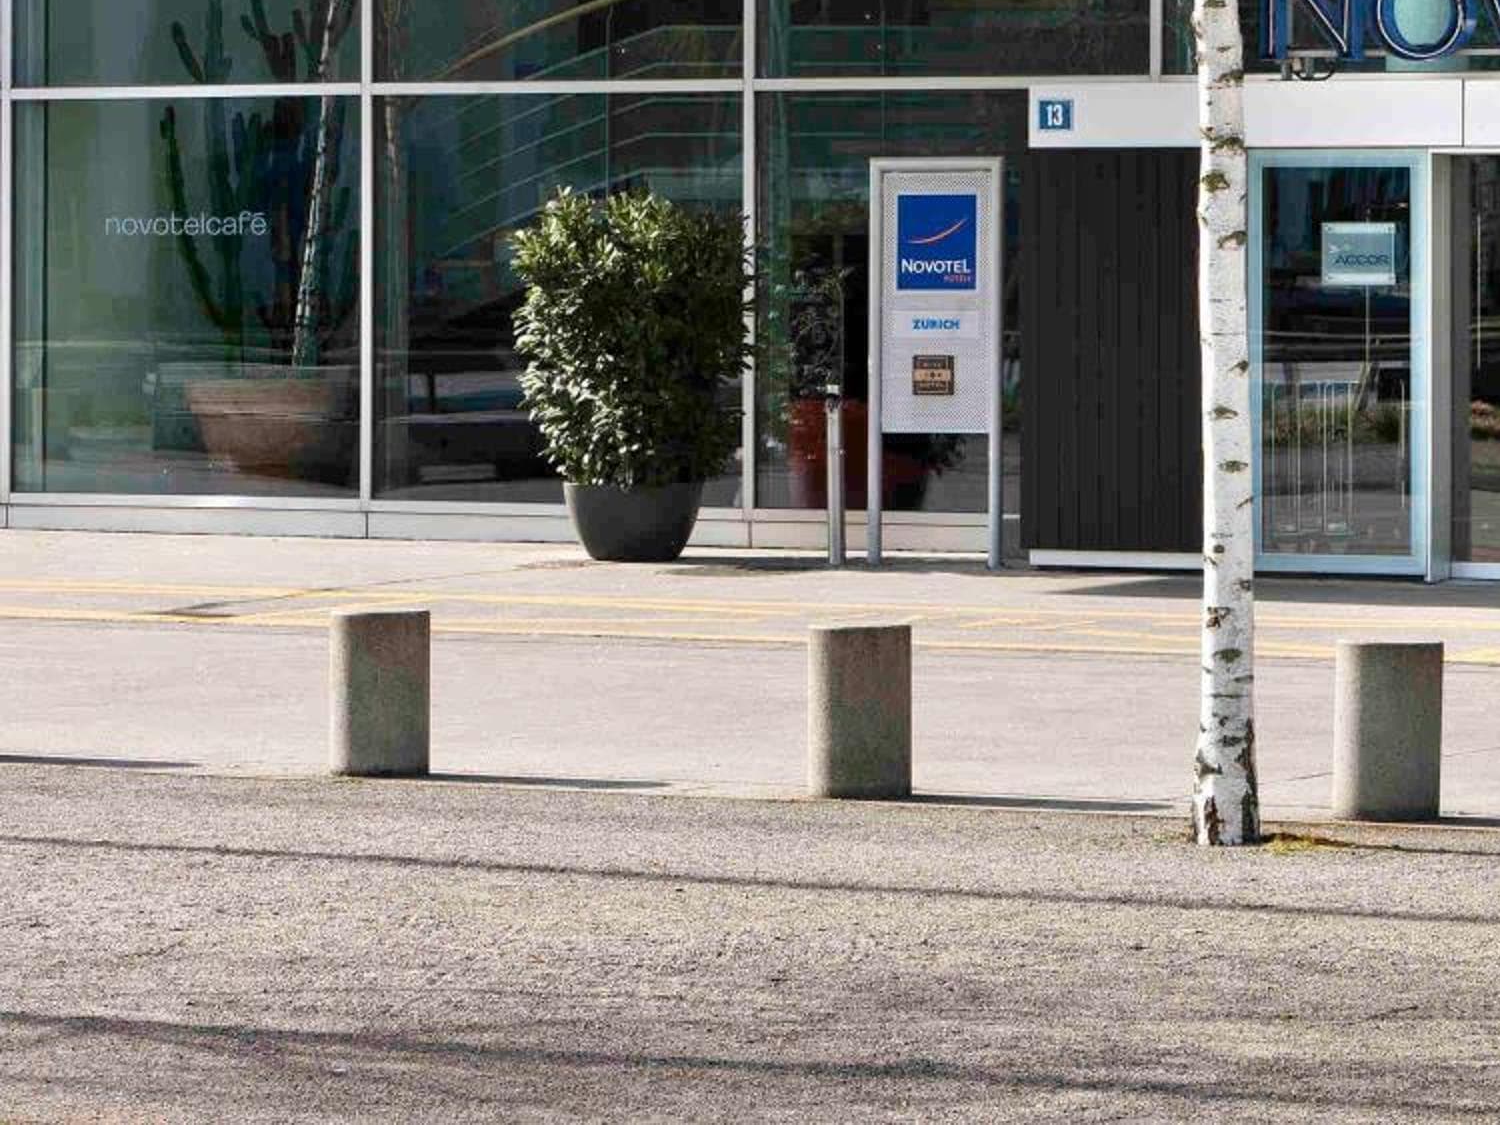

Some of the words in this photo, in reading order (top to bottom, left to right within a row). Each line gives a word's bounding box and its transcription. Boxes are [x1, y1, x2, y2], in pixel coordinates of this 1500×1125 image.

[1045, 104, 1064, 127] 13
[104, 210, 268, 236] novotelcafé
[901, 258, 971, 274] NOVOTEL
[1334, 254, 1390, 267] ACCOR
